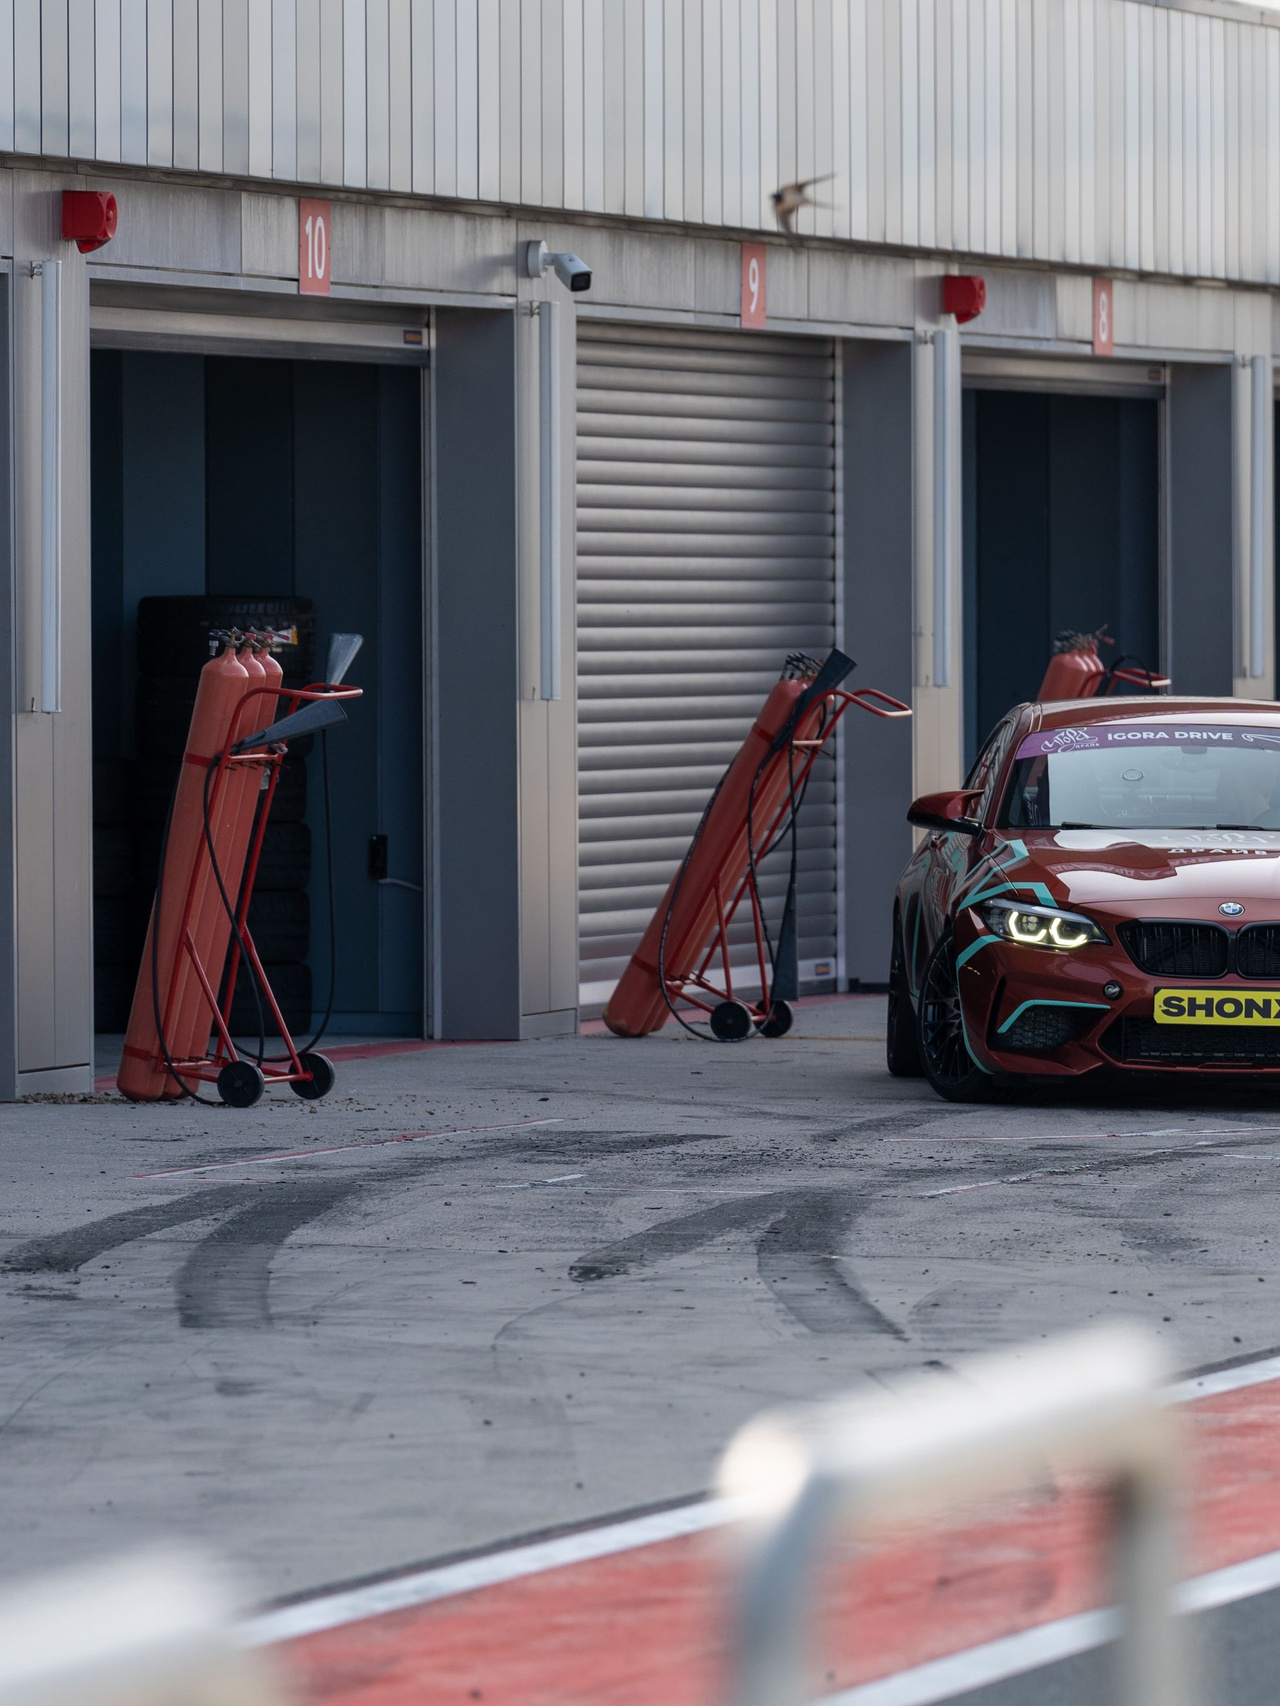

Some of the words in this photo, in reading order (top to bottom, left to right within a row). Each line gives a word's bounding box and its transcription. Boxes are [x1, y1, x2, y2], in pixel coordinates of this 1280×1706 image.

[305, 215, 326, 280] 10
[749, 257, 759, 314] 9
[1099, 291, 1109, 343] 8
[1107, 731, 1170, 741] IGORA
[1174, 731, 1234, 741] DRIVE
